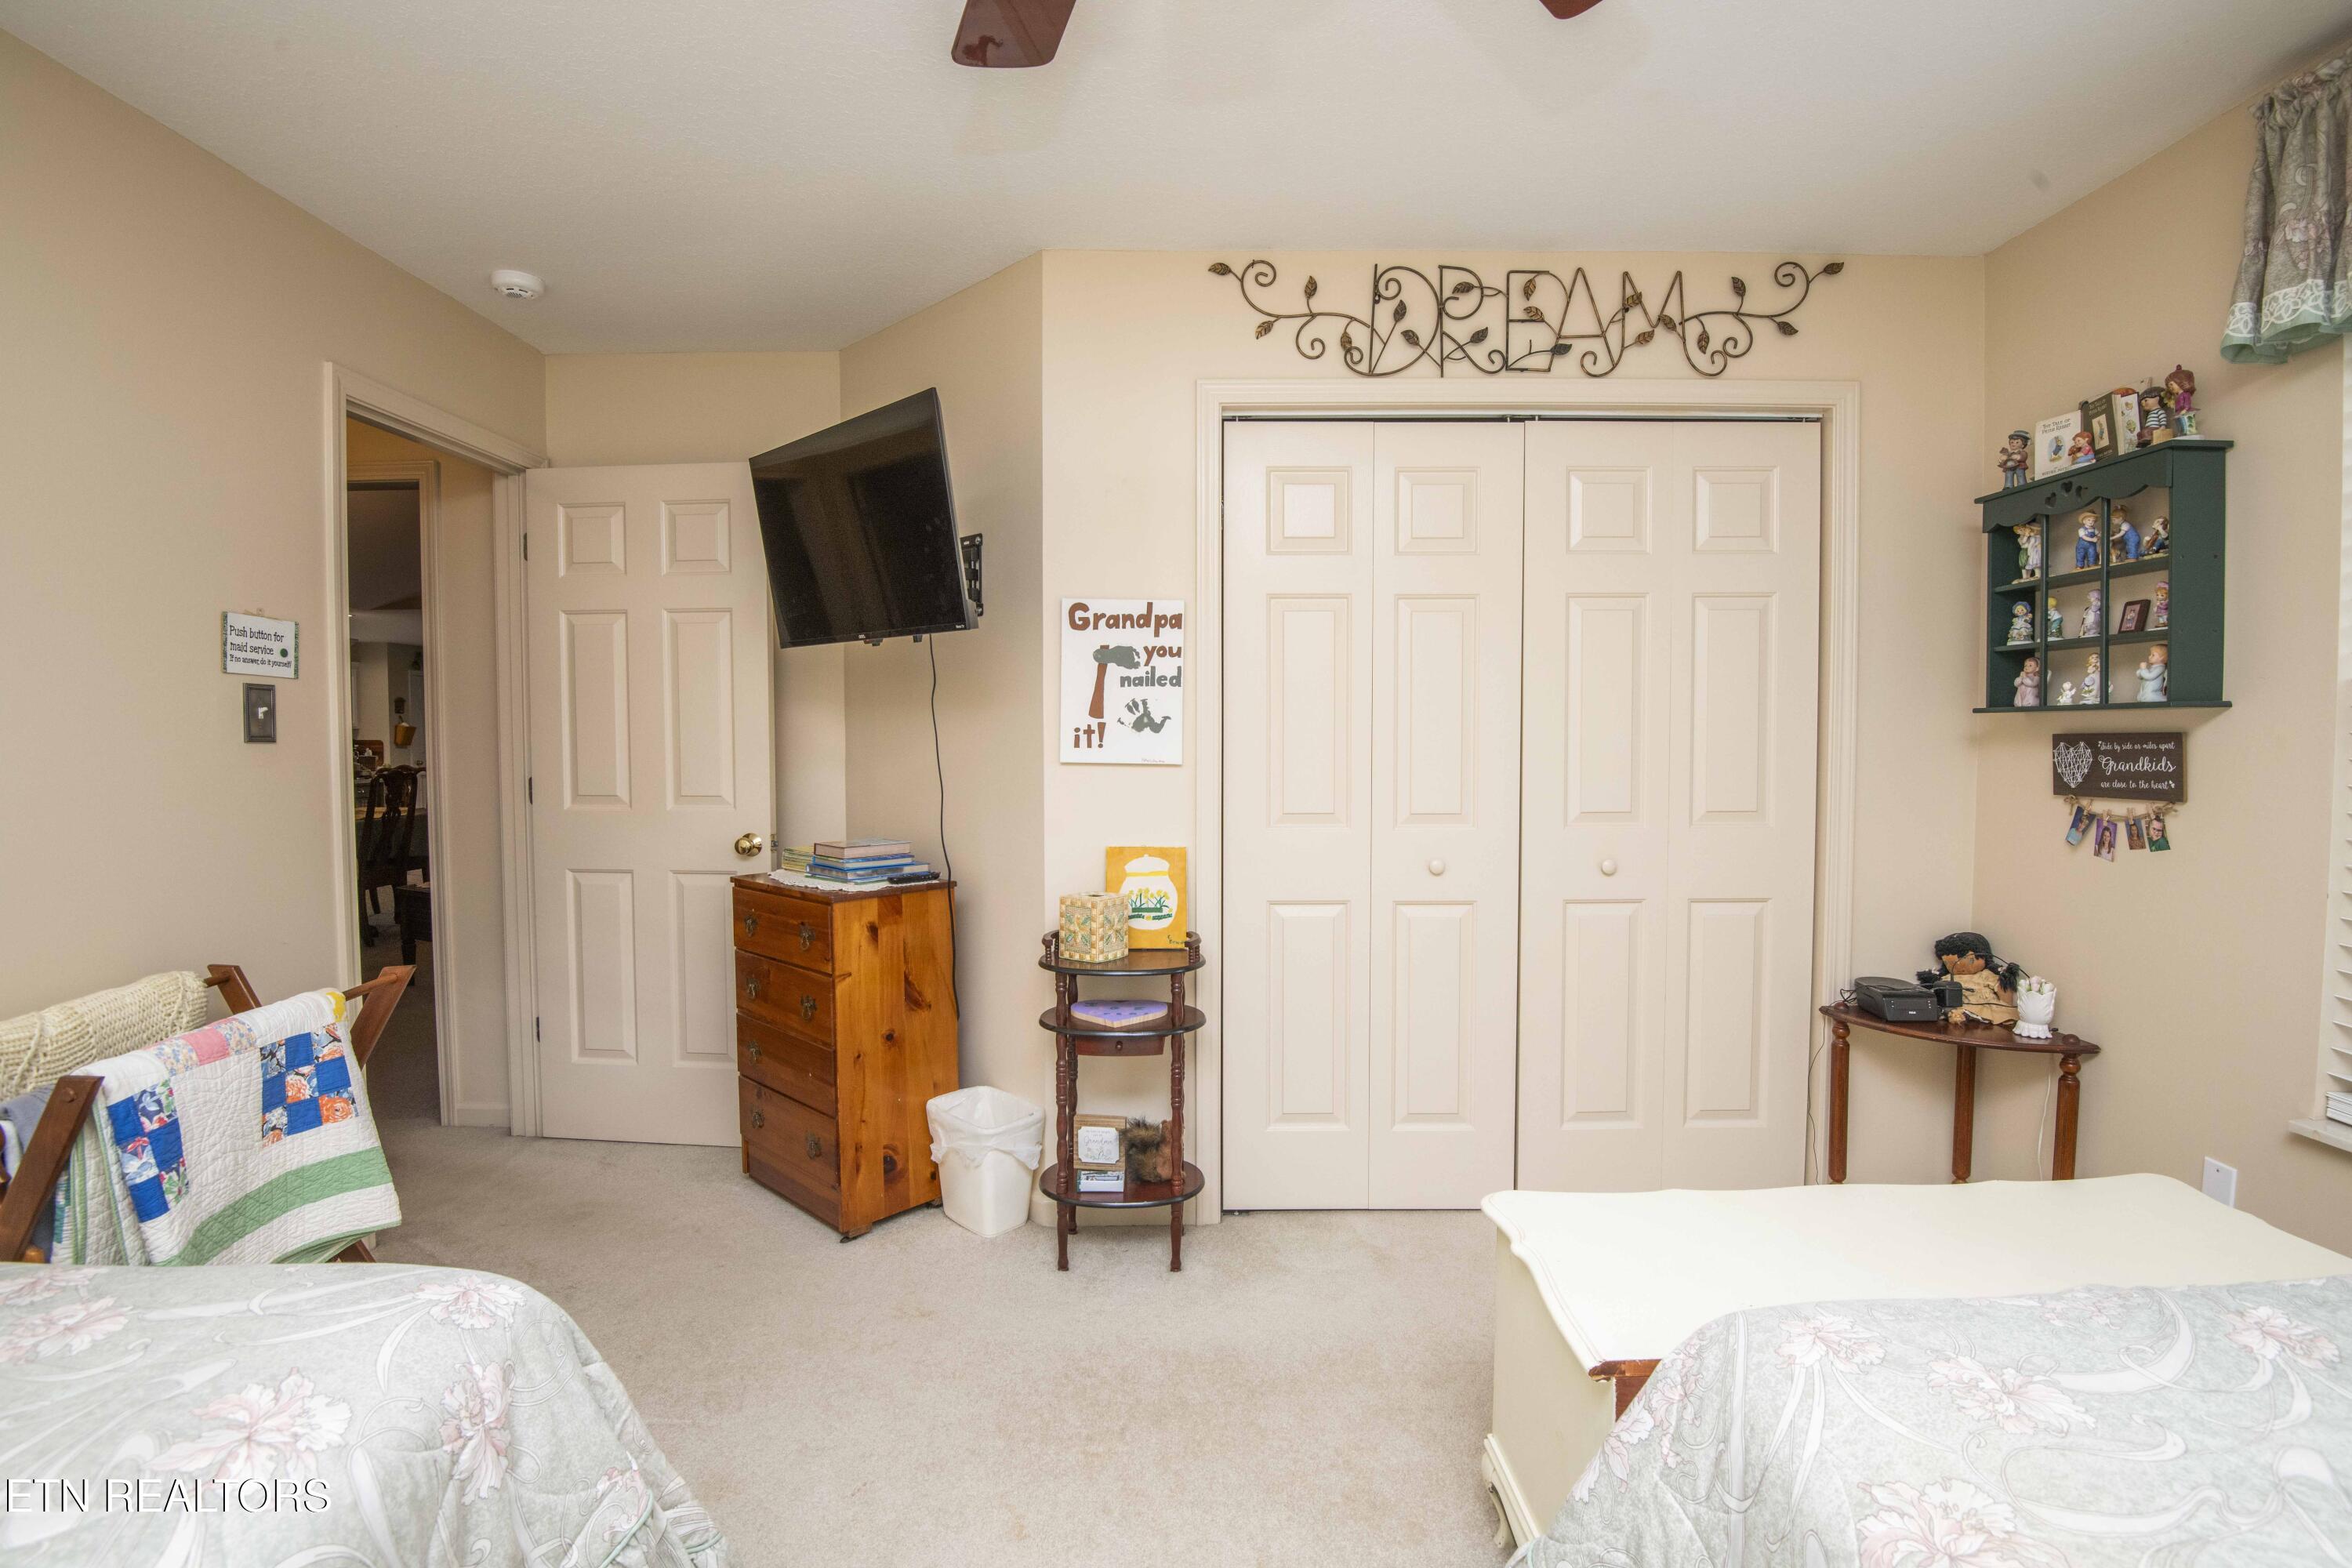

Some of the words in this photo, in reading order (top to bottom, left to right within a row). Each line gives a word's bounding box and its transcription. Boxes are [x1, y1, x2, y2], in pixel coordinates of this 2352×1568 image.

[1346, 263, 1727, 377] DREAM
[1068, 601, 1183, 637] Grandpa
[230, 625, 248, 638] Push
[250, 628, 272, 641] button
[274, 632, 285, 642] for
[230, 642, 248, 652] maid
[249, 645, 274, 655] service
[1143, 645, 1182, 666] you
[1120, 666, 1182, 688] nailed
[1073, 721, 1107, 749] it!
[2114, 742, 2121, 753] by
[2158, 742, 2176, 751] apart
[2098, 755, 2176, 775] Grandkids
[2112, 779, 2127, 788] close
[2139, 779, 2149, 789] the
[2151, 779, 2169, 789] heart
